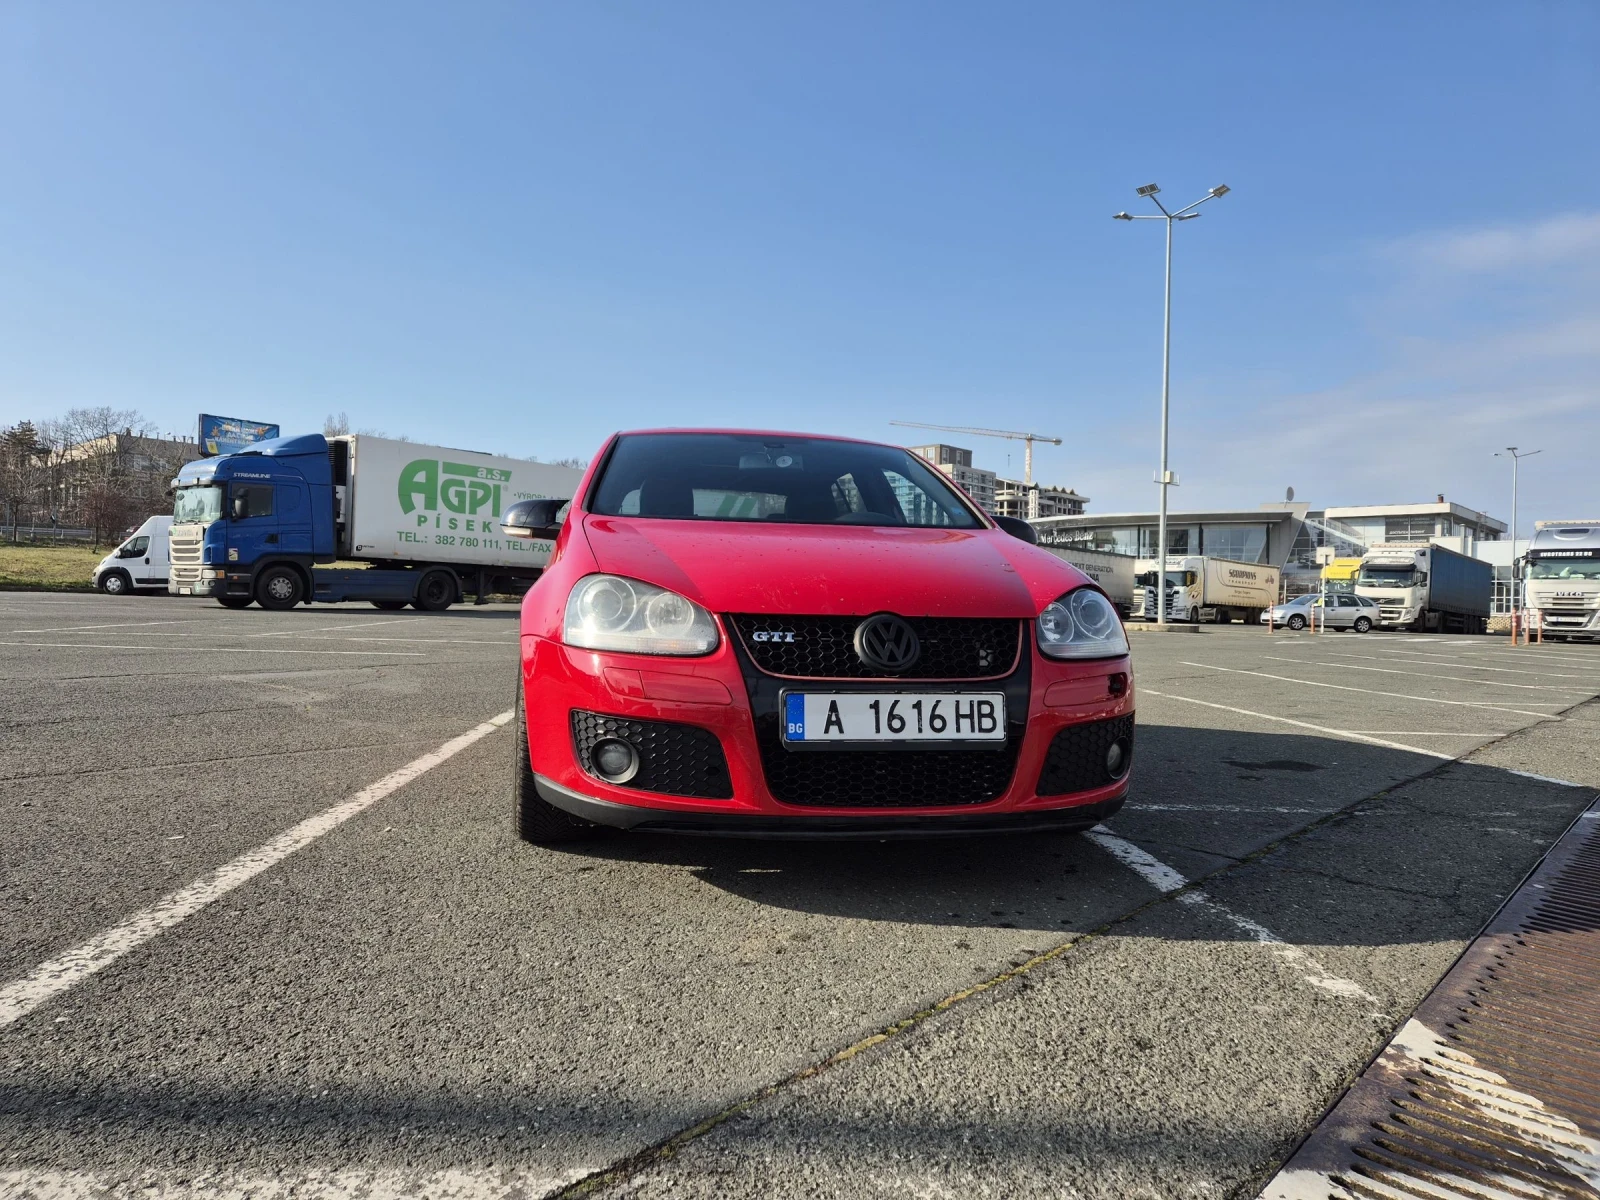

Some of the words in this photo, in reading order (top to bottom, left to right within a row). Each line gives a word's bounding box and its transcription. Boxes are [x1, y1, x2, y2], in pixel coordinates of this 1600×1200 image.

[477, 467, 505, 481] a.s.
[397, 458, 501, 518] AGPI
[417, 513, 492, 533] PÍSEK
[396, 531, 428, 543] TEL.:
[434, 535, 456, 546] 382
[459, 537, 479, 547] 780
[482, 539, 502, 550] 111,
[506, 540, 552, 553] TEL./FAX
[752, 631, 795, 643] GTI
[823, 699, 845, 734] A
[788, 723, 803, 734] BG
